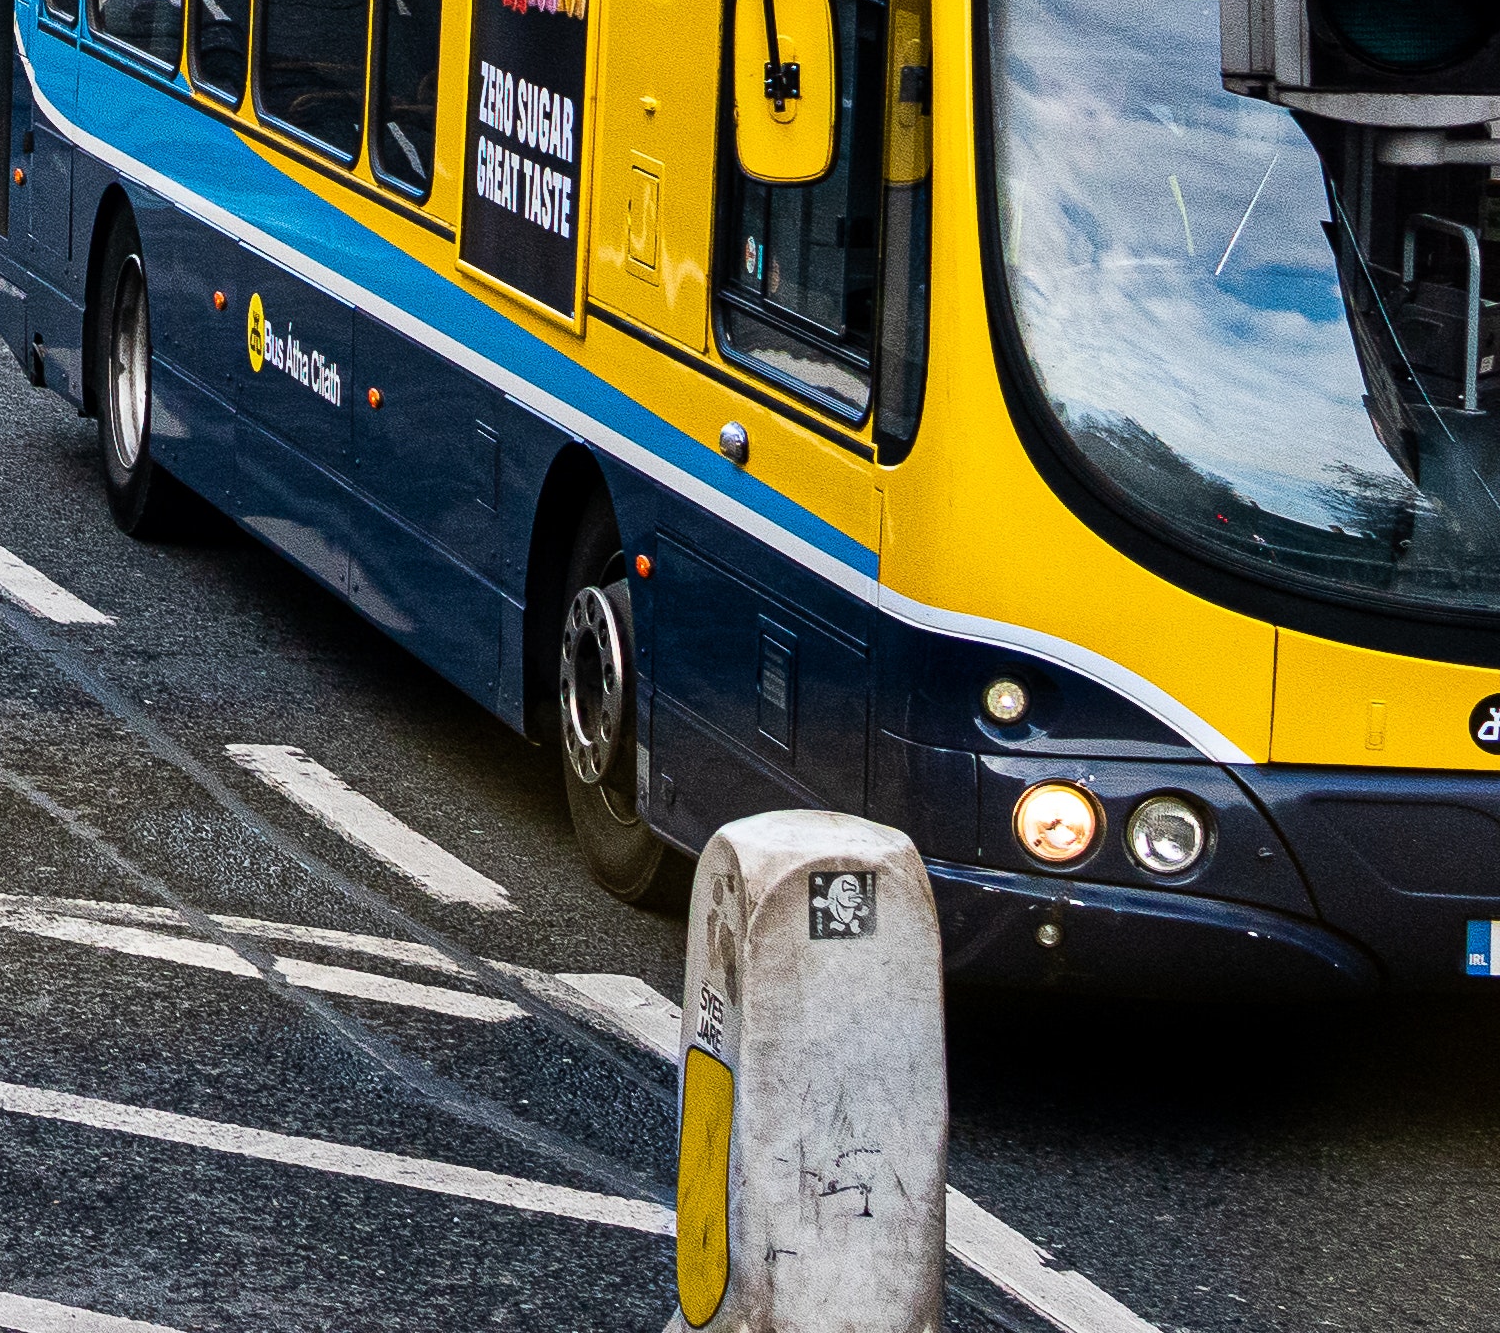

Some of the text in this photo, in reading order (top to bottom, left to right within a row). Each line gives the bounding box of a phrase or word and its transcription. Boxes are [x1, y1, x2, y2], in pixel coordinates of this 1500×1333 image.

[479, 60, 575, 163] ZERO SUGAR
[476, 135, 572, 239] GREAT TASTE
[264, 319, 341, 407] Bus Átha Cliath
[1469, 953, 1488, 966] IRL
